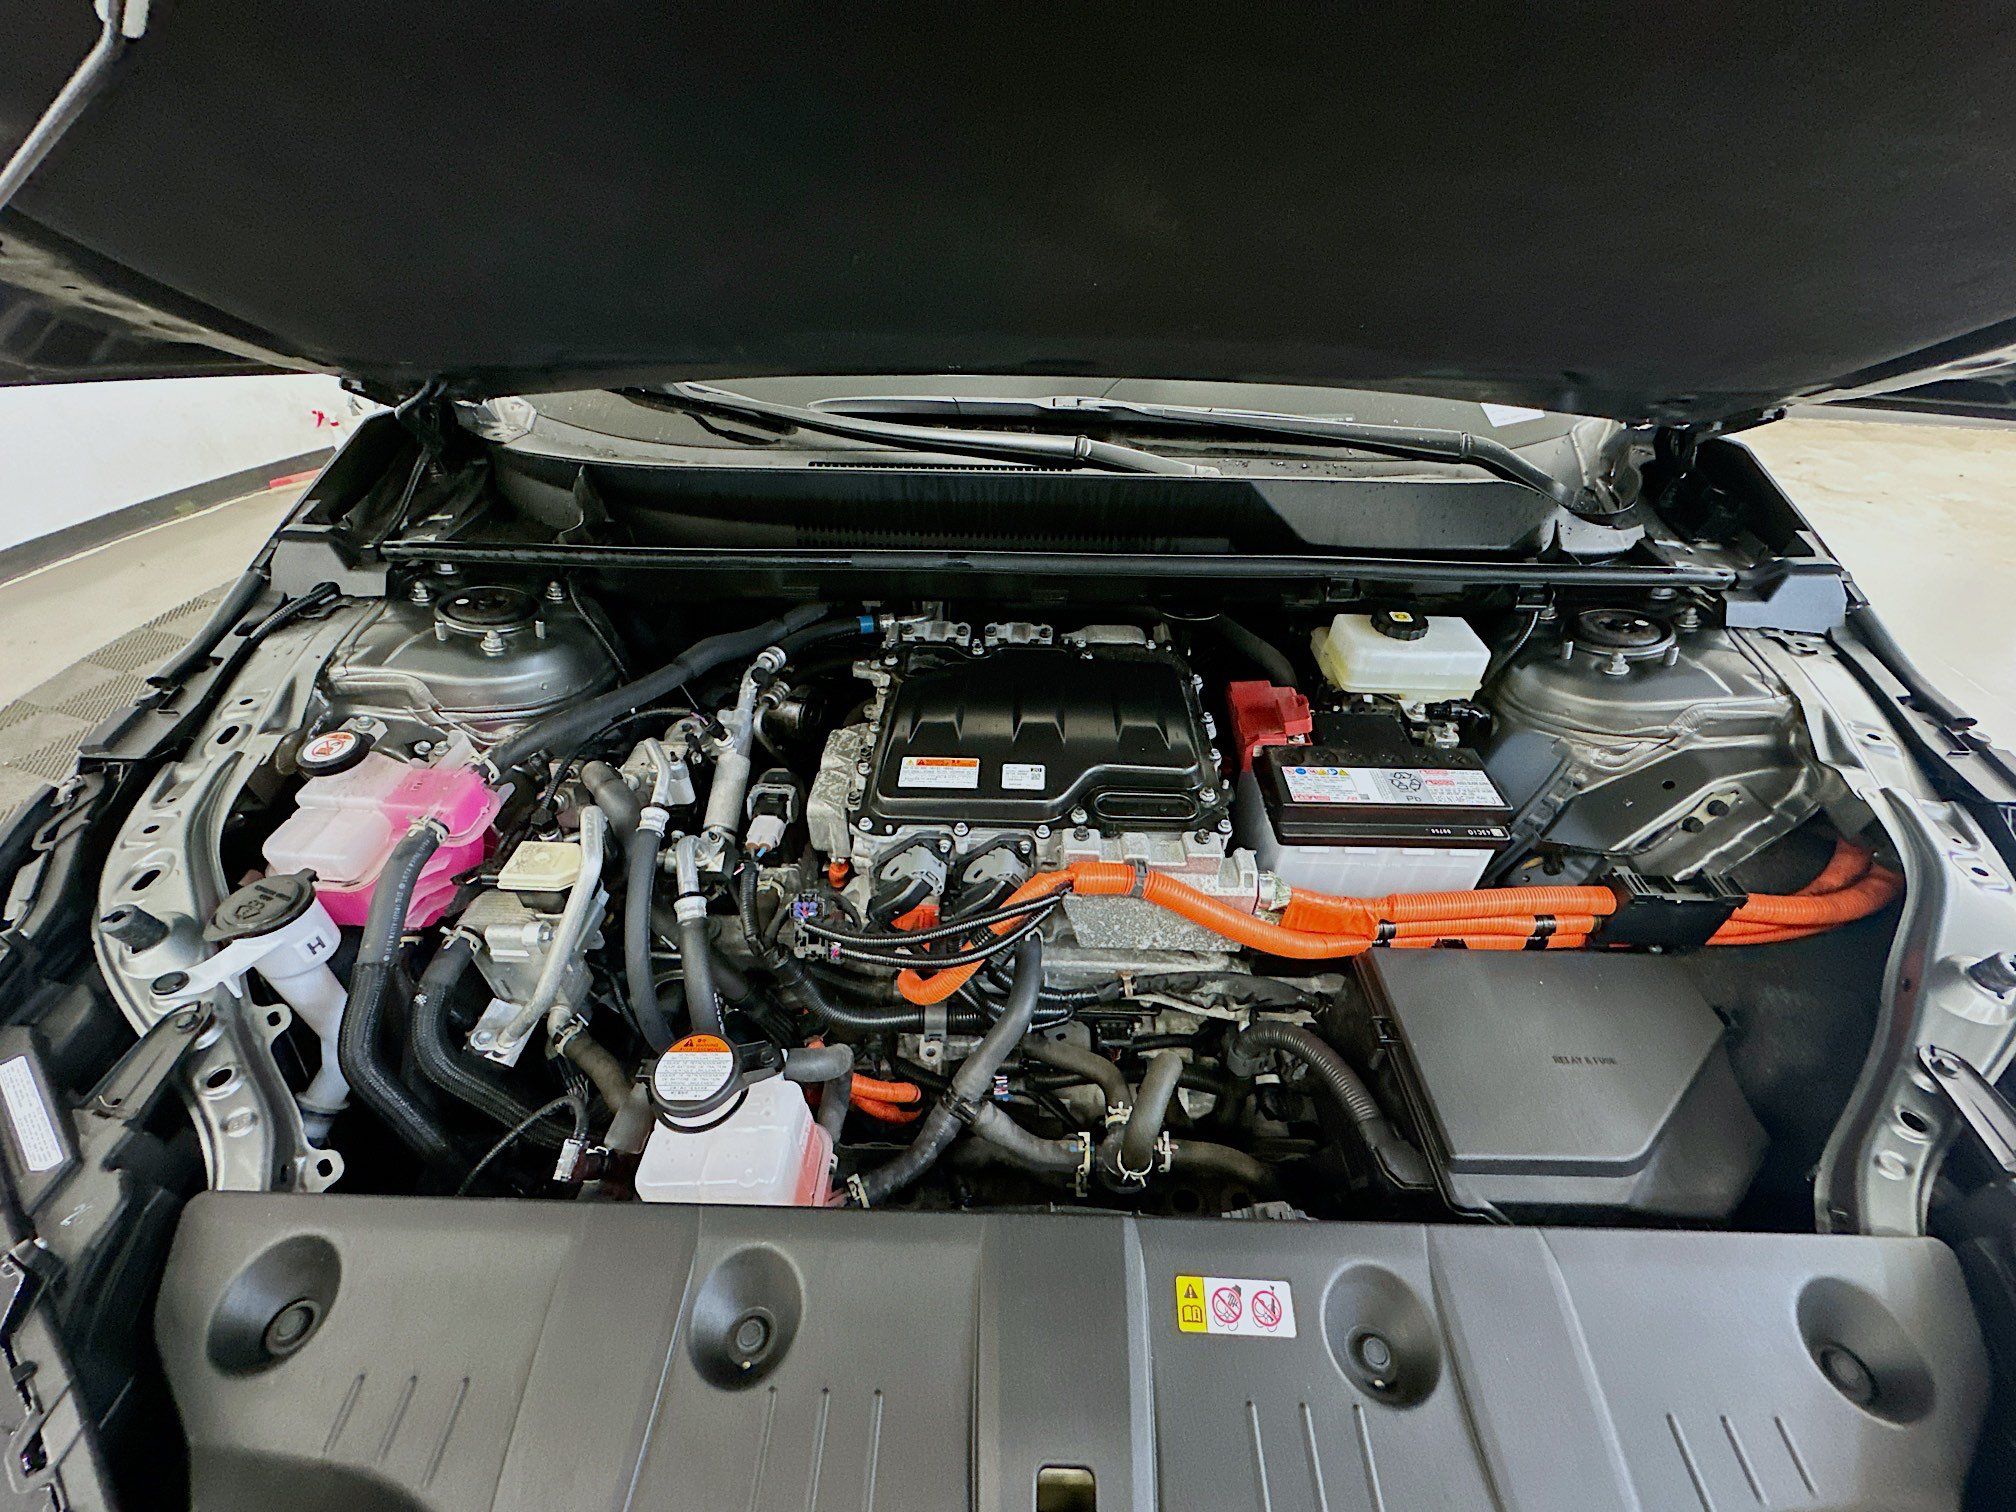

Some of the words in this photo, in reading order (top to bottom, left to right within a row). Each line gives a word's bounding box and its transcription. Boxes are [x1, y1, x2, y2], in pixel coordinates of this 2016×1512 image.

[1406, 795, 1422, 803] Pb
[306, 935, 326, 955] H
[1552, 1055, 1583, 1065] RELAY
